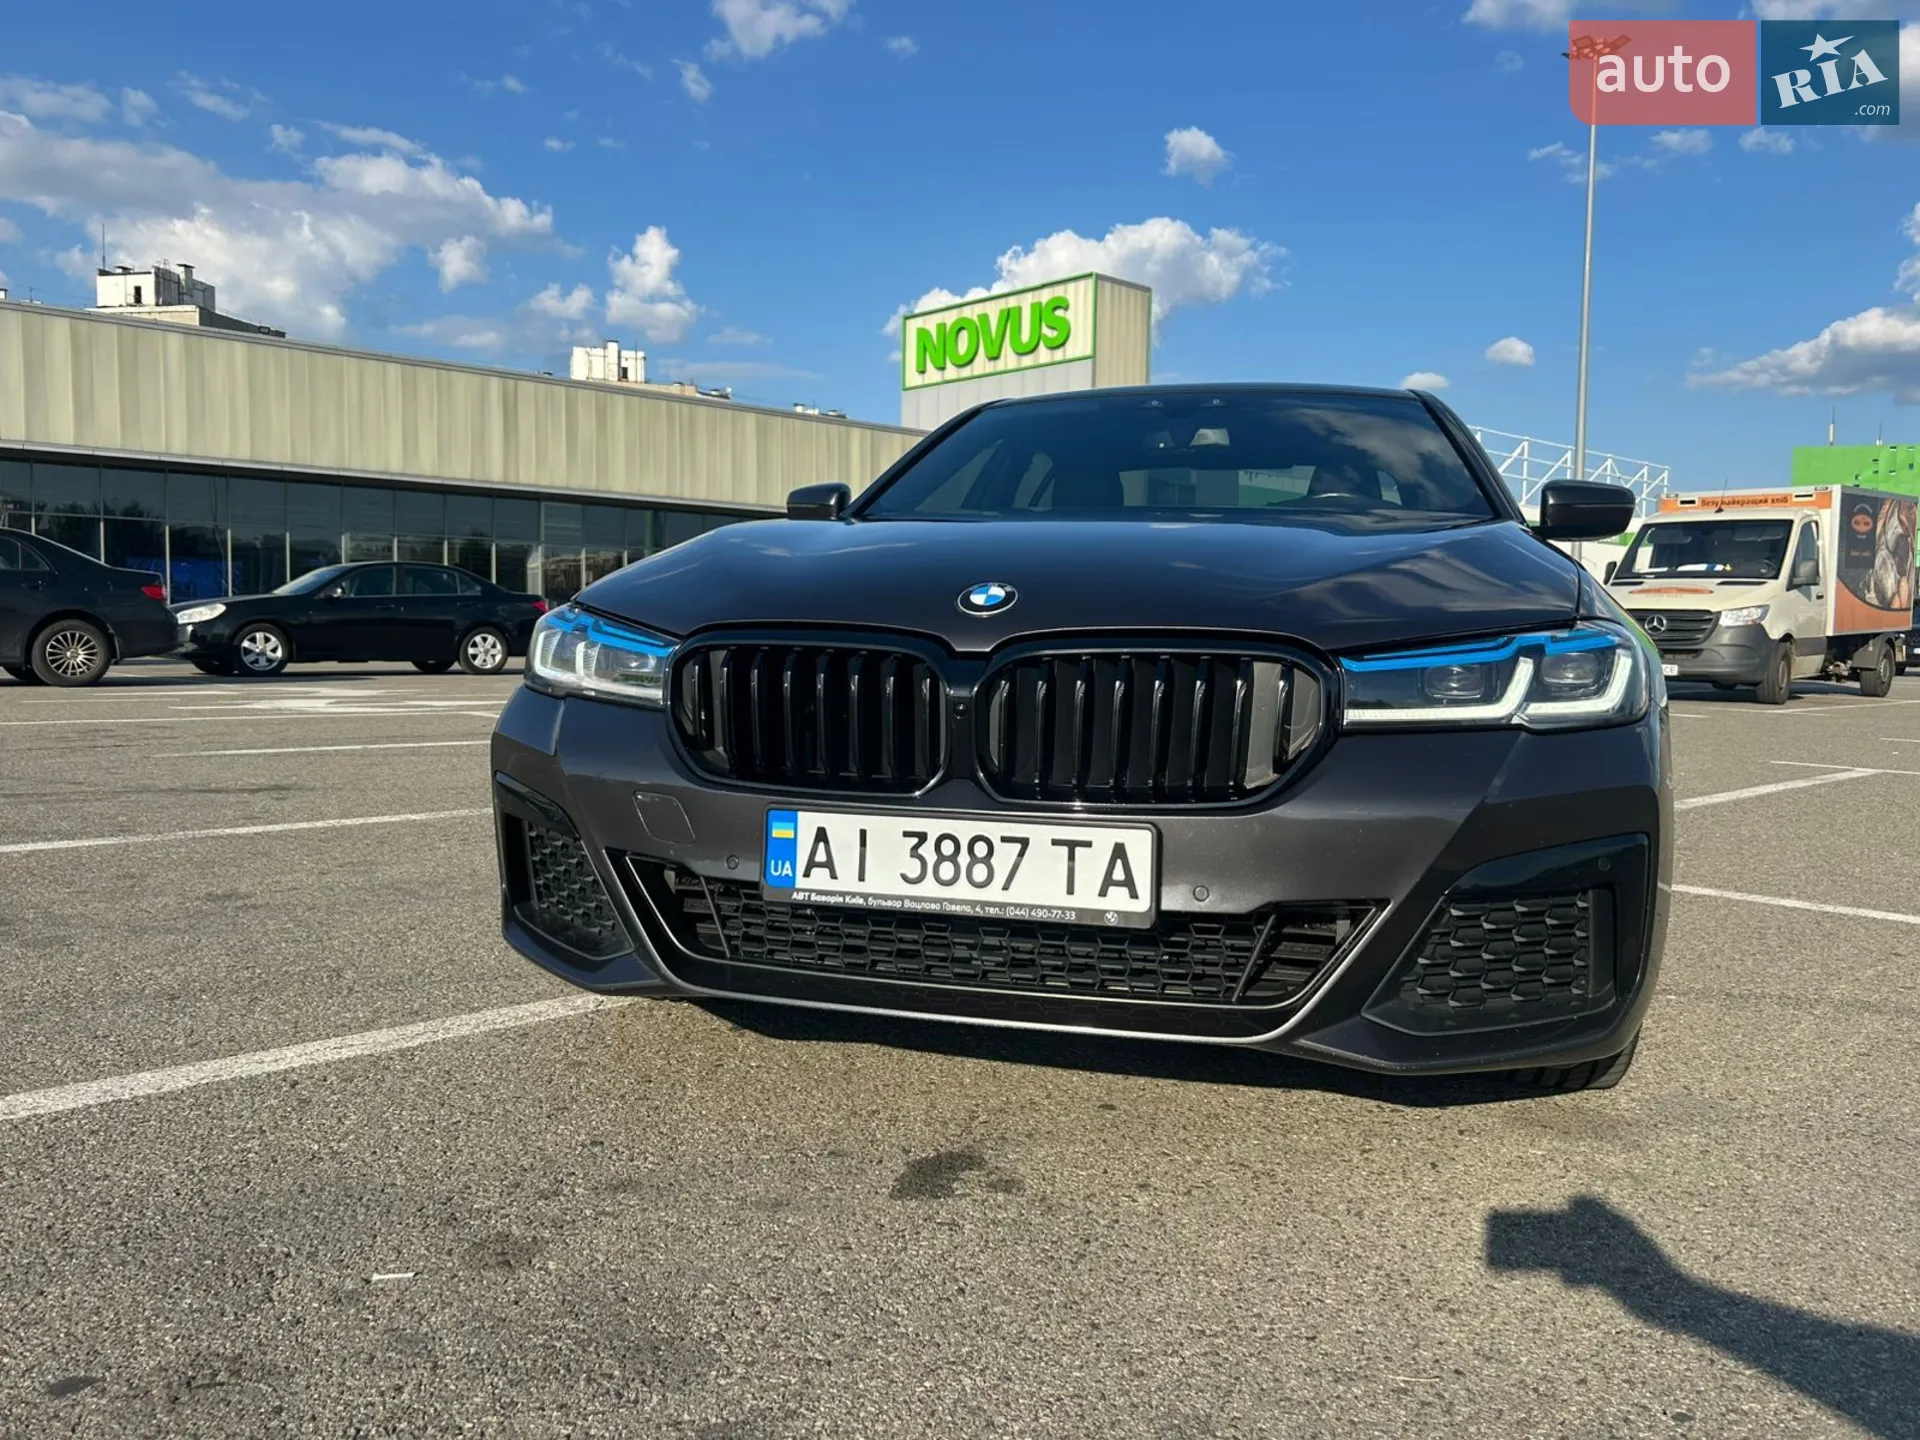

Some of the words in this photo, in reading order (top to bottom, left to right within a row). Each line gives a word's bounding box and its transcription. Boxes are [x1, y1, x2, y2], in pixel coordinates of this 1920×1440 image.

[915, 295, 1071, 374] NOVUS
[770, 859, 793, 877] UA
[802, 826, 867, 882] AI
[900, 830, 1030, 891] 3887
[1050, 838, 1140, 900] TA
[867, 897, 902, 908] бульвар
[904, 899, 941, 911] Вацлава
[943, 902, 974, 914] Гавела,
[975, 904, 984, 914] 4,
[1006, 906, 1029, 918] (044)
[1030, 908, 1076, 920] 490-77-33
